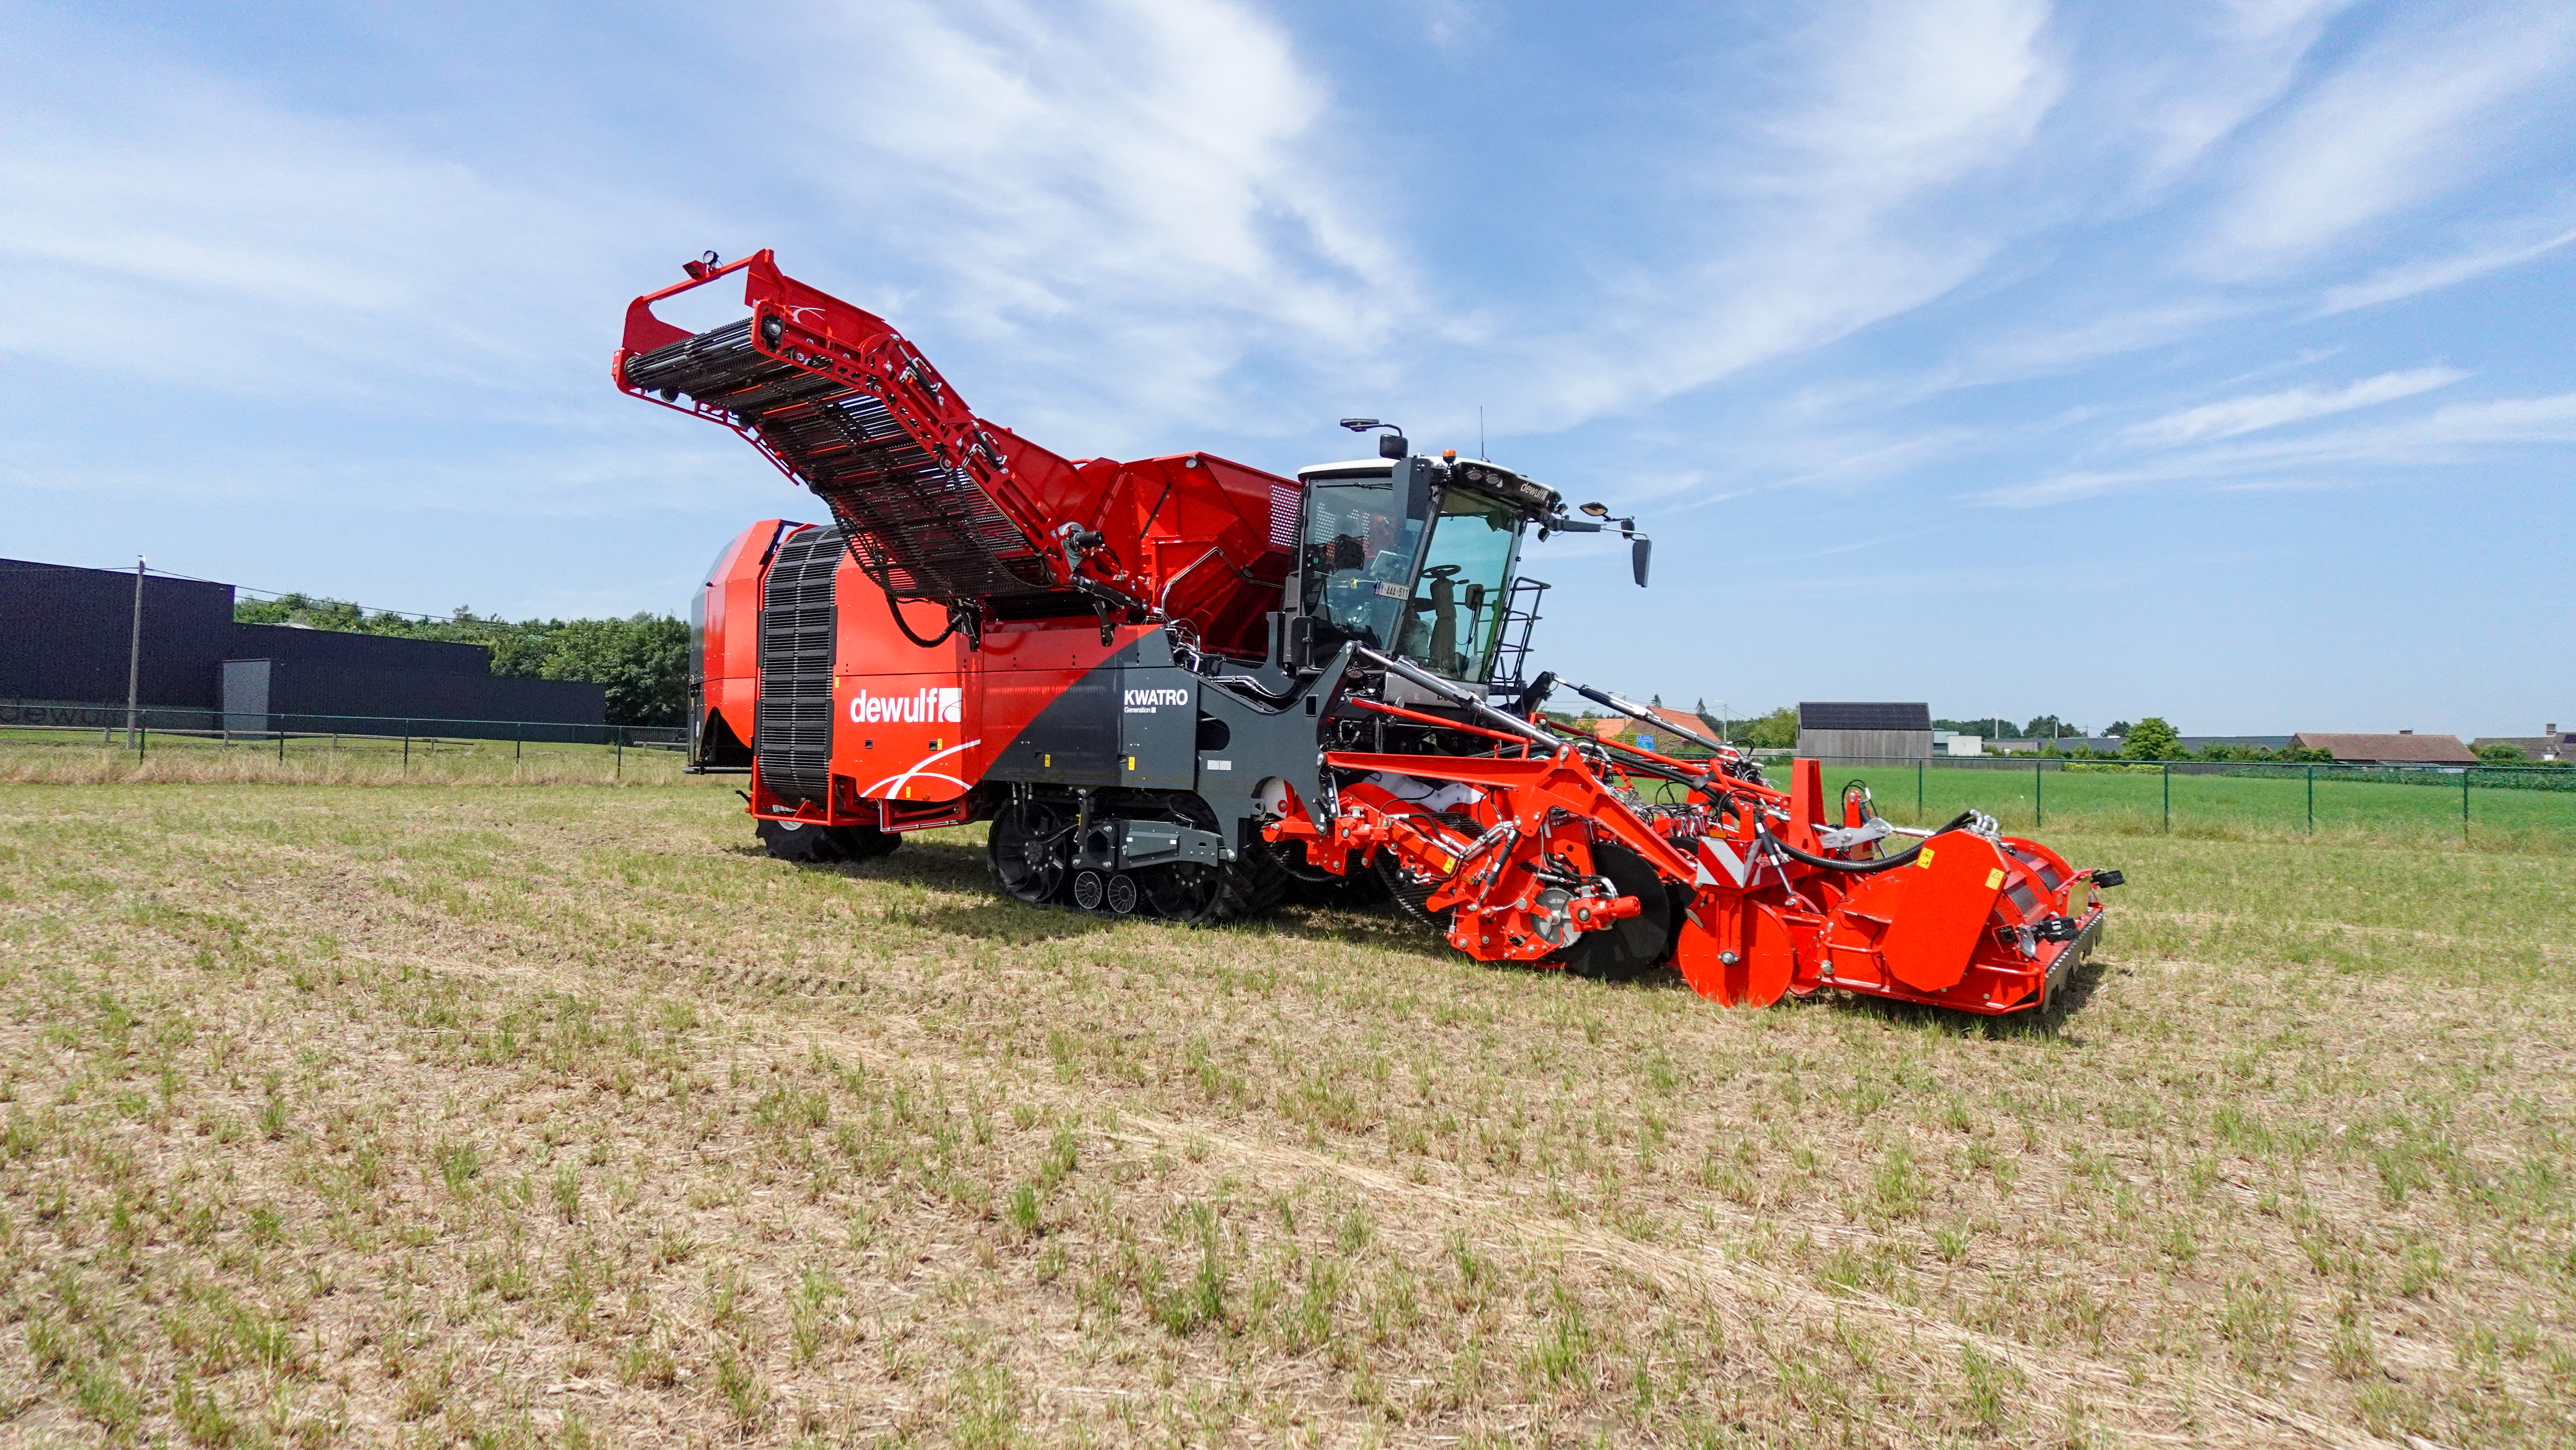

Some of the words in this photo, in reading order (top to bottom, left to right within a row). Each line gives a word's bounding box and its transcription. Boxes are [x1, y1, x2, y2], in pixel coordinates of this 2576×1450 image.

[1520, 482, 1546, 499] dewulf
[850, 688, 938, 723] dewulf
[1124, 689, 1188, 706] KWATRO
